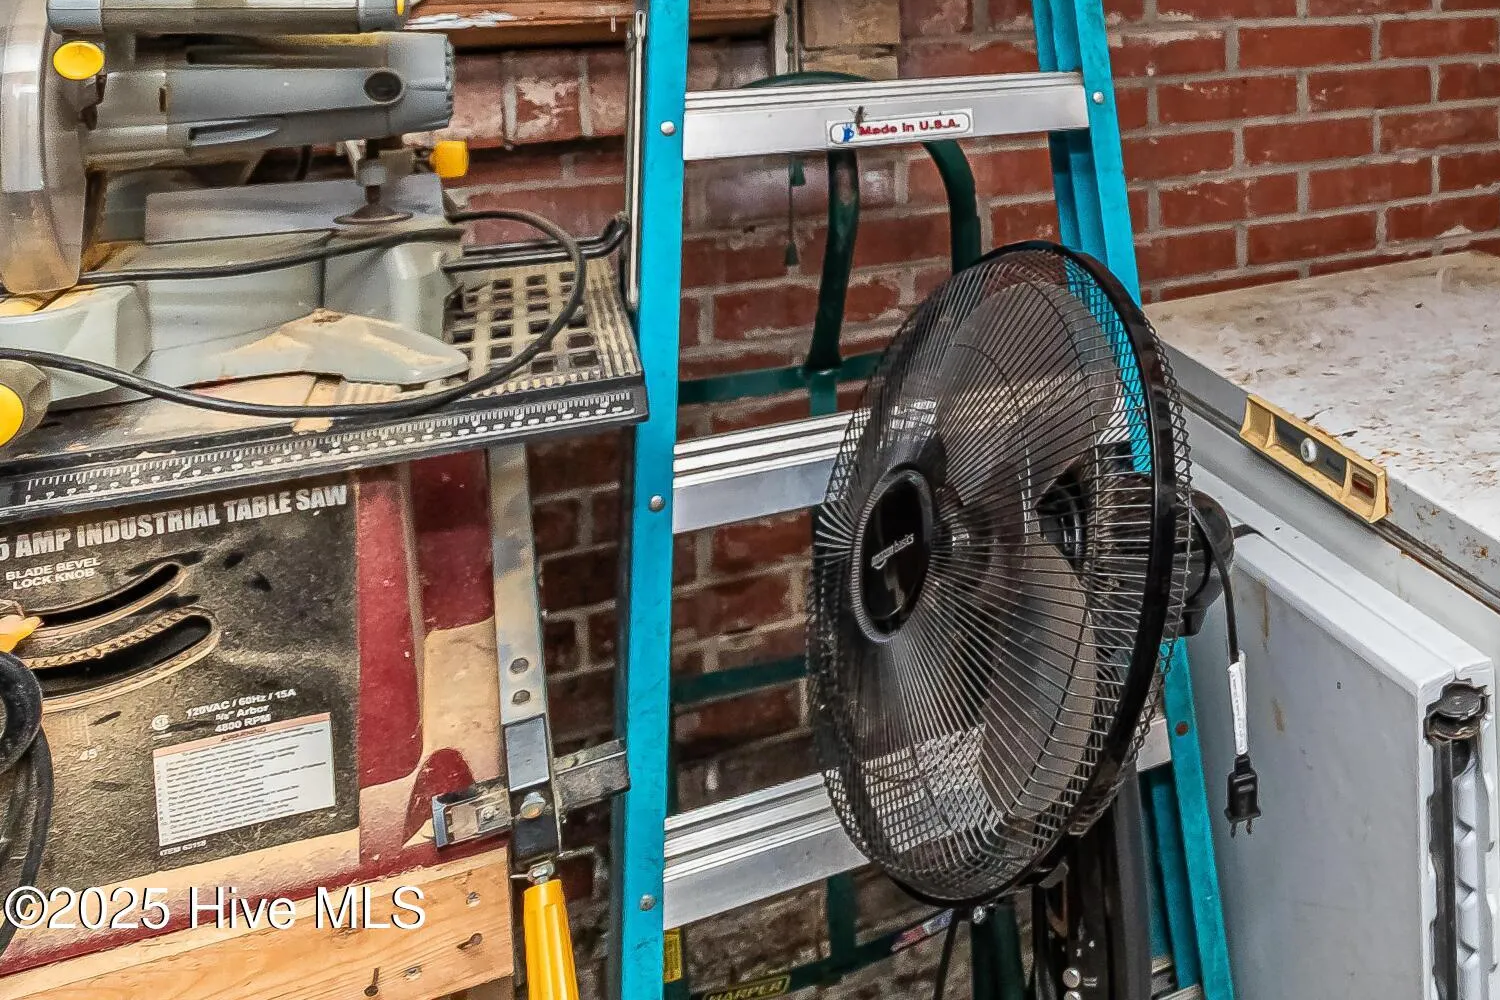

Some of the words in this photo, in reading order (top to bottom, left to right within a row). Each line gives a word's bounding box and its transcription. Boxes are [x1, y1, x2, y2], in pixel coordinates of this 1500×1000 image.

[858, 124, 897, 136] Made
[902, 122, 915, 133] in
[919, 118, 961, 131] U.S.A.
[16, 528, 71, 558] AMP
[76, 512, 220, 548] INDUSTRIAL
[223, 491, 292, 524] TABLE
[296, 485, 347, 509] SAW
[6, 563, 53, 580] BLADE
[55, 556, 100, 572] BEVEL
[13, 574, 54, 589] LOCK
[54, 567, 95, 583] KNOB
[186, 699, 231, 719] 120VAC
[238, 694, 268, 707] 60Hz
[275, 688, 297, 699] 15A
[236, 704, 270, 718] Arbor
[214, 720, 242, 733] 4800
[244, 713, 272, 727] RPM
